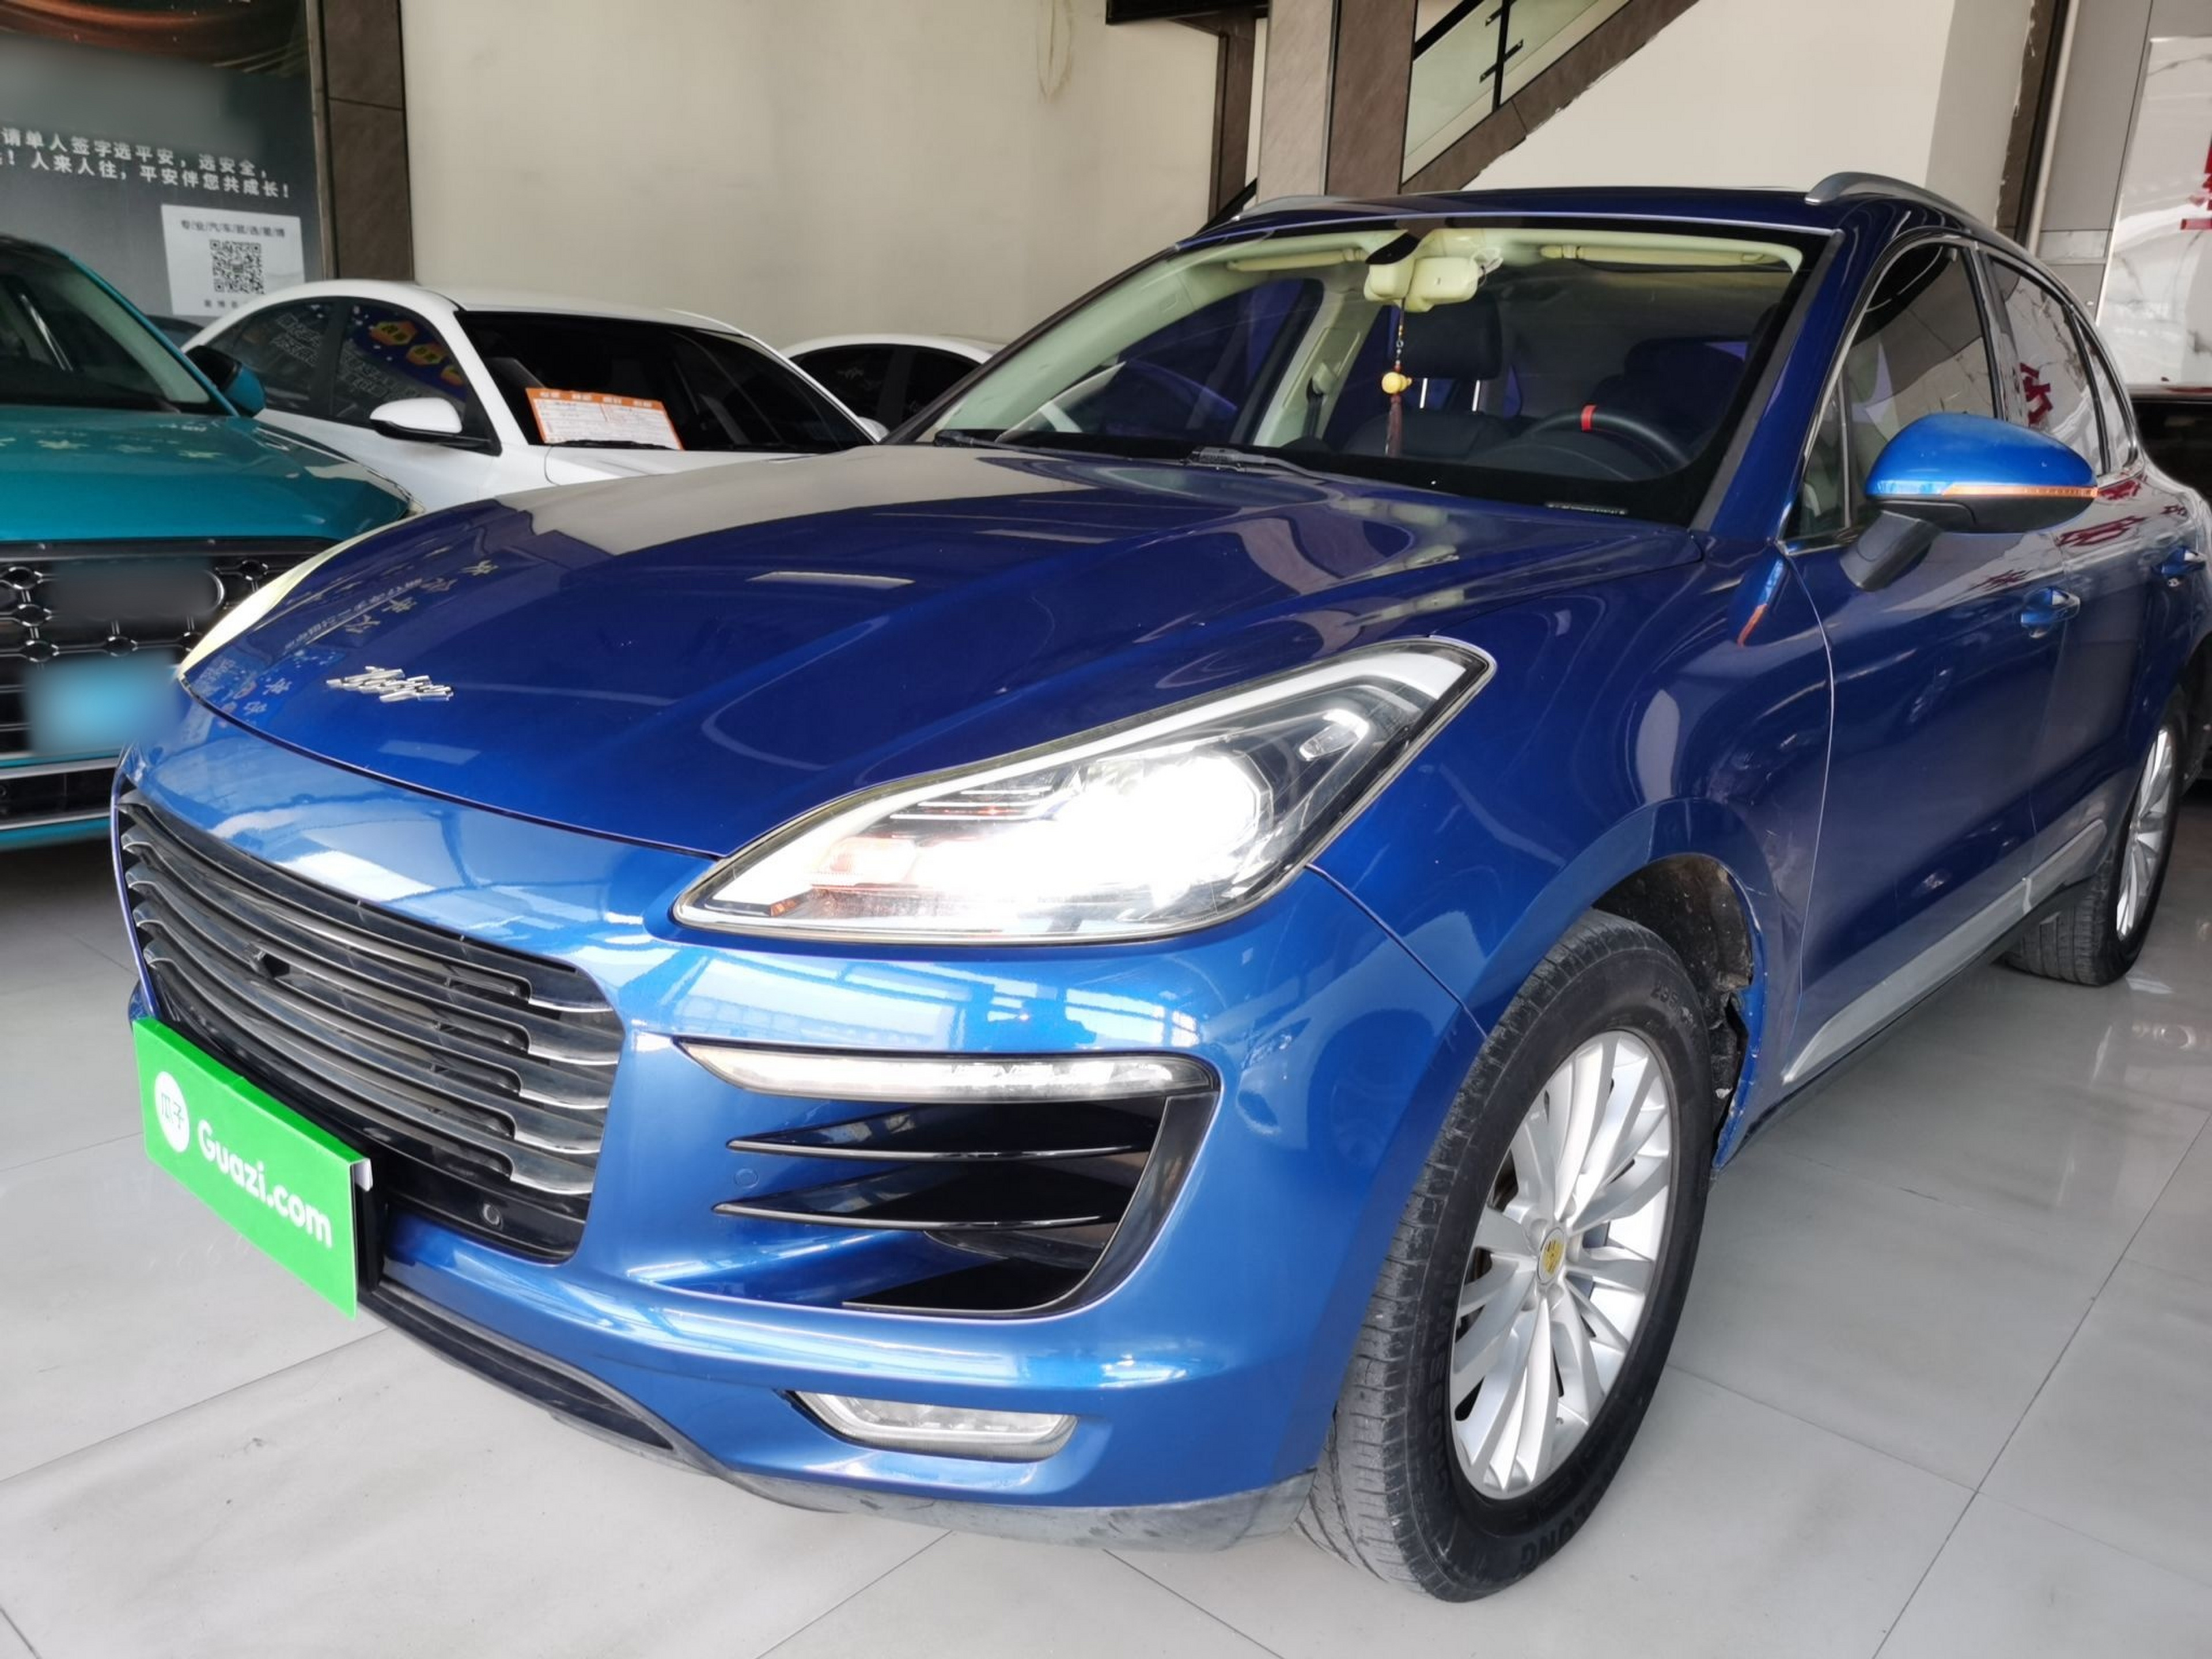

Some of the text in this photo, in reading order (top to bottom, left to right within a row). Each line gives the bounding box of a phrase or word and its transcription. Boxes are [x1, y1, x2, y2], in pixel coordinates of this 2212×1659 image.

[0, 149, 289, 198] ！人来人往，平安伴您共成长！
[197, 1119, 332, 1249] Guazi.com
